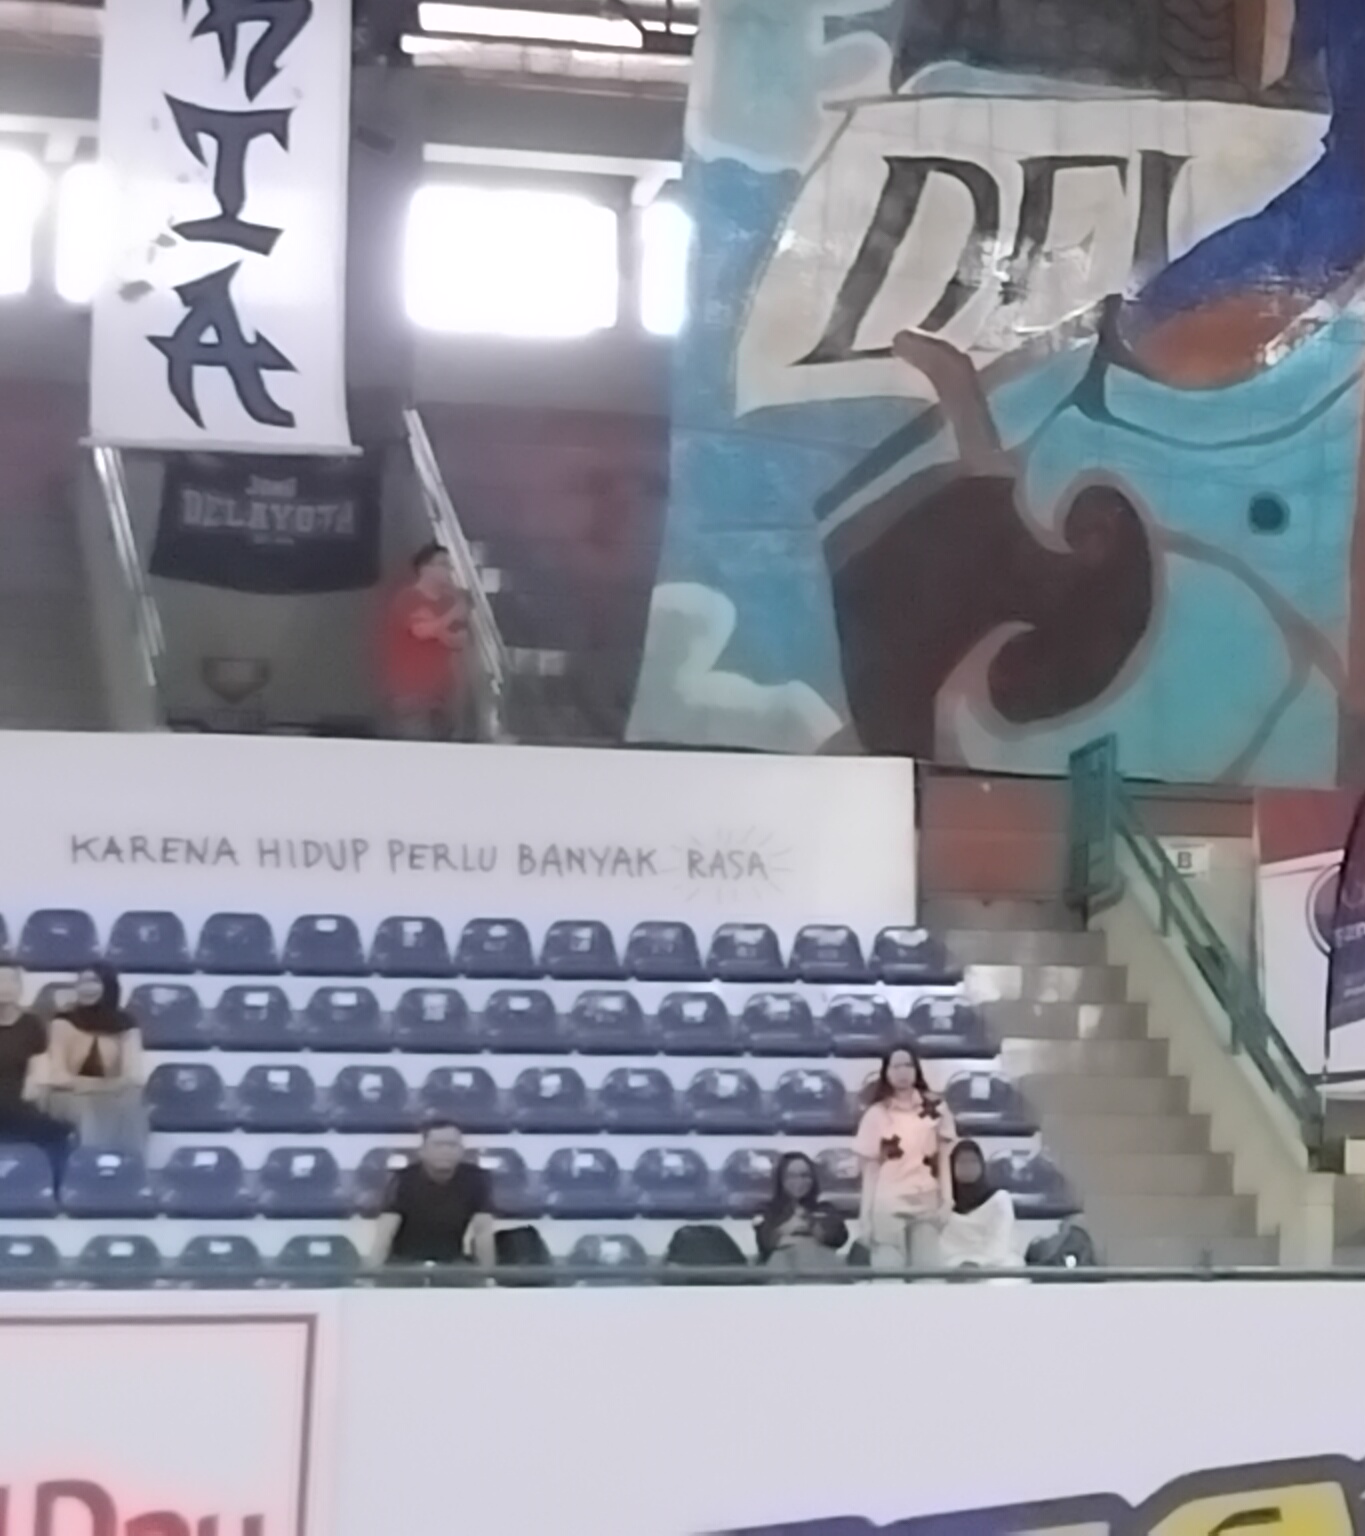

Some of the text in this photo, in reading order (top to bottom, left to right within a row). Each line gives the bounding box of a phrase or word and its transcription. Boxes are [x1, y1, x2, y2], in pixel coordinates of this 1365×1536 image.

[70, 835, 770, 879] KARENA HIDUP PERLU BANYAK RASA
